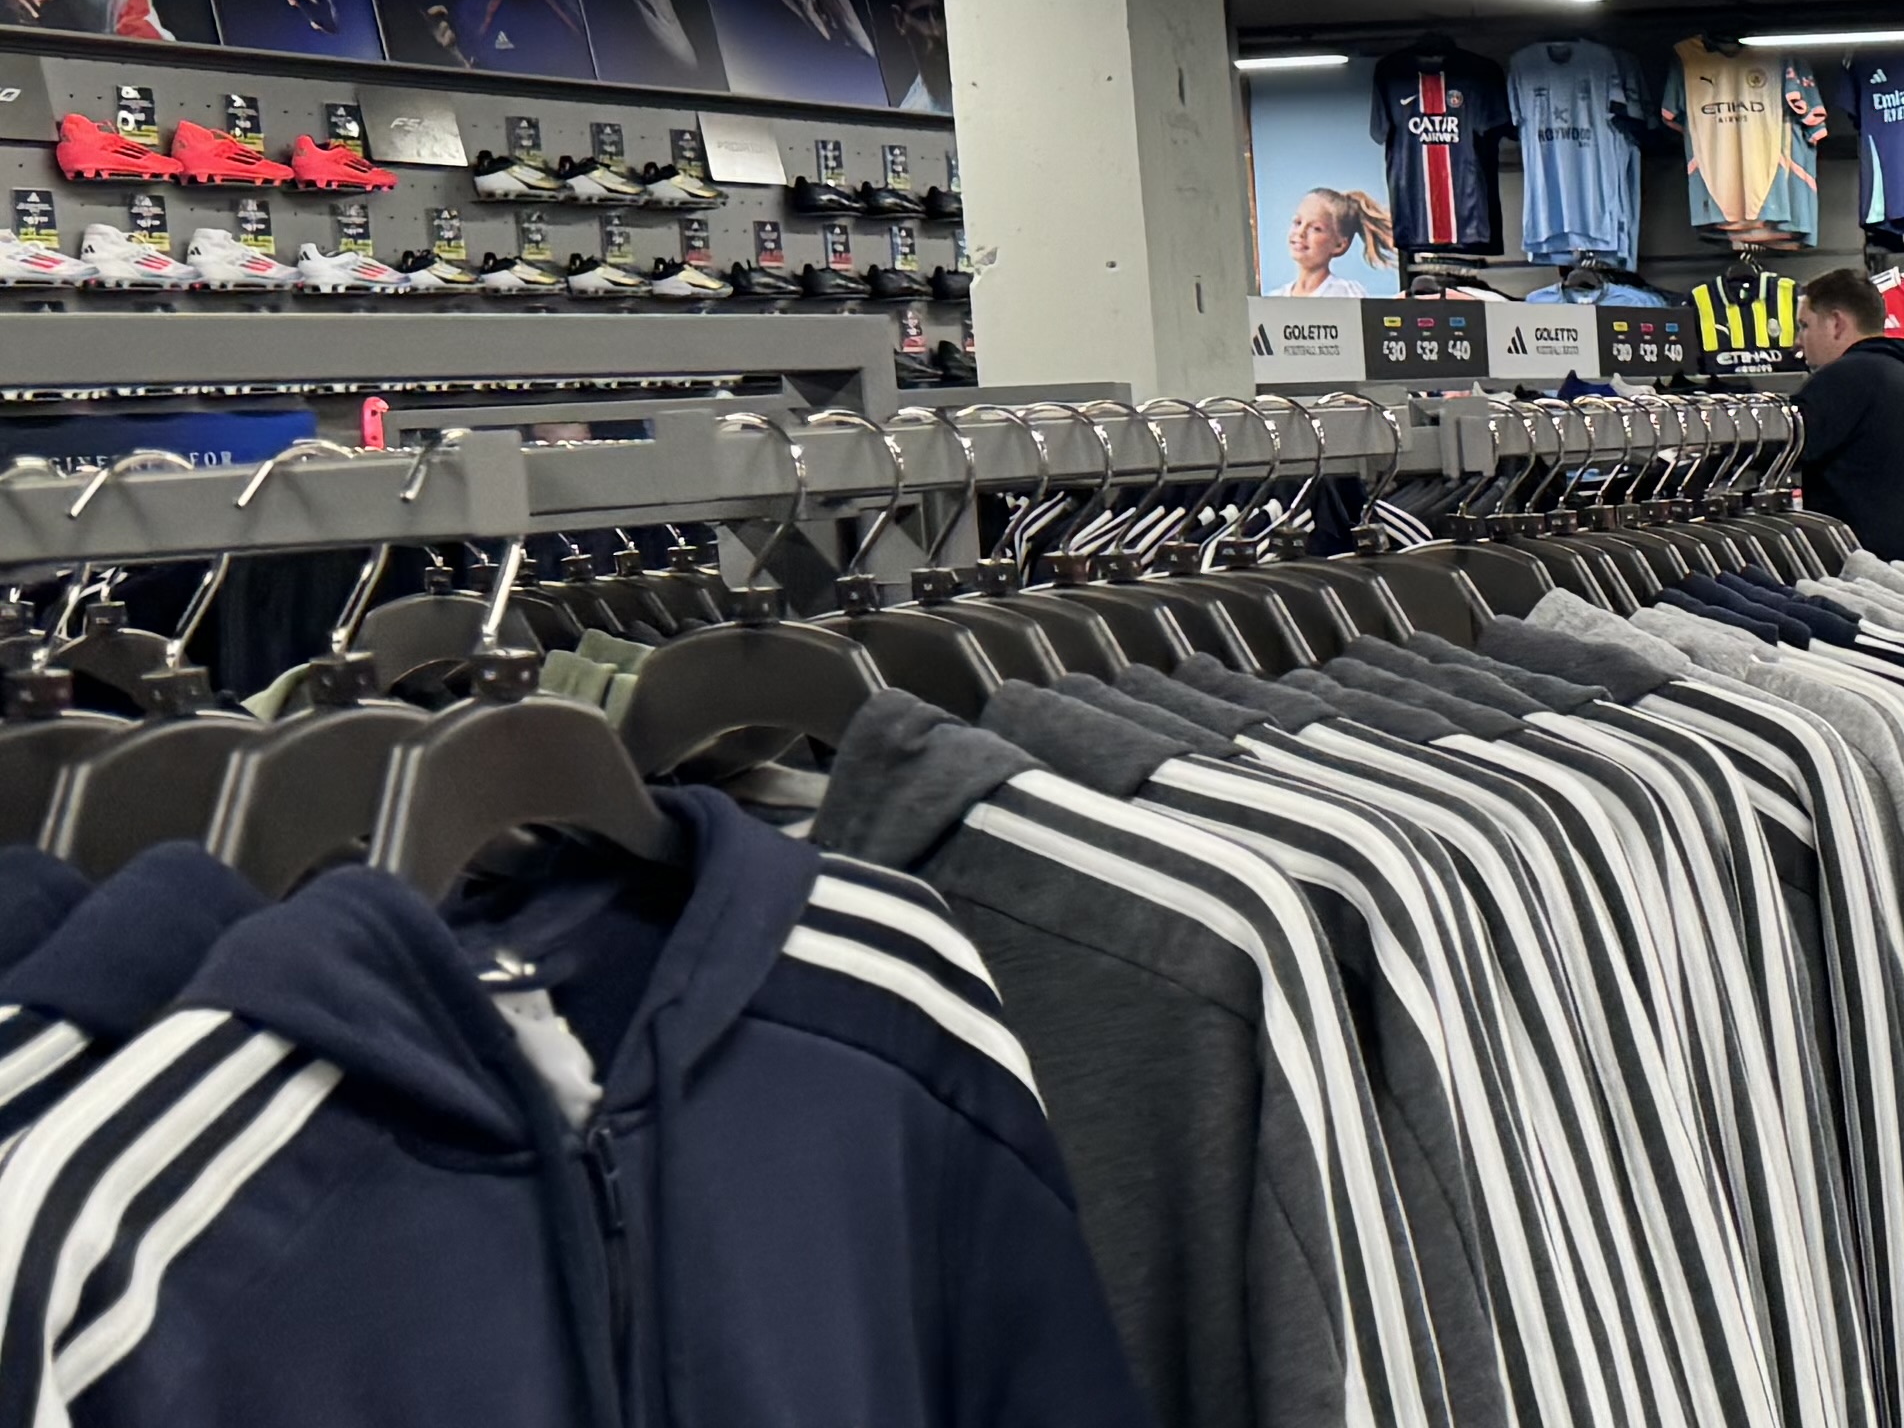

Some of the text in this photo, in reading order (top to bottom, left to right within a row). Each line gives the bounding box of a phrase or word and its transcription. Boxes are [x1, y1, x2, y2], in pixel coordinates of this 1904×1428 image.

[1701, 101, 1765, 115] ETIHAD
[1408, 116, 1459, 134] QATAR
[1283, 324, 1339, 341] GOLETTO
[1535, 327, 1578, 341] GOLETTO
[1383, 340, 1407, 362] £30
[1416, 340, 1438, 361] £32
[1448, 340, 1471, 360] £40
